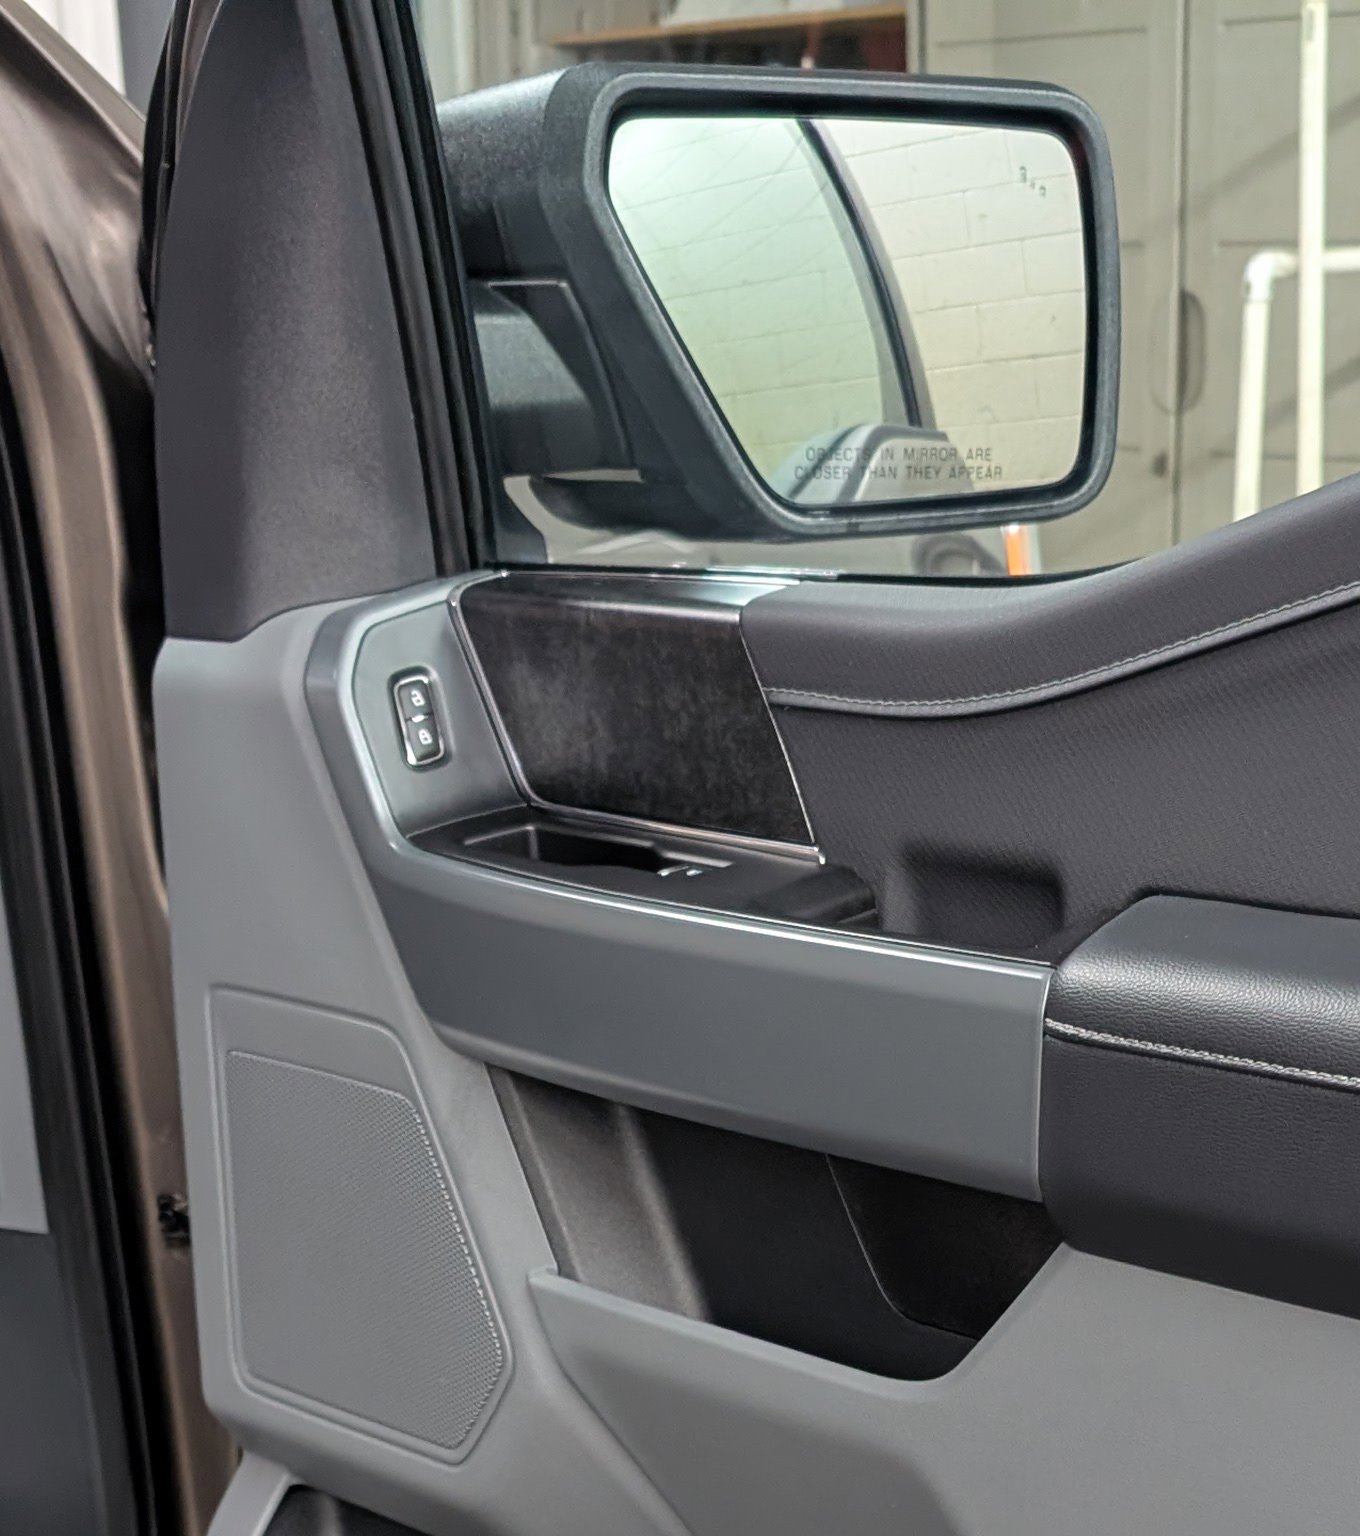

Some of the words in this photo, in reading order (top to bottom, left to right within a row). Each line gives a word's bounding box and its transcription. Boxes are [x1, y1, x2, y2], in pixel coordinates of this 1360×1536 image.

[805, 447, 870, 462] OBJECTS
[881, 448, 894, 461] IN
[903, 447, 958, 461] MIRROR
[966, 447, 993, 461] ARE
[794, 466, 850, 480] CLOSER
[859, 466, 897, 480] THAN
[906, 466, 941, 480] THEY
[948, 466, 1003, 480] APPEAR
